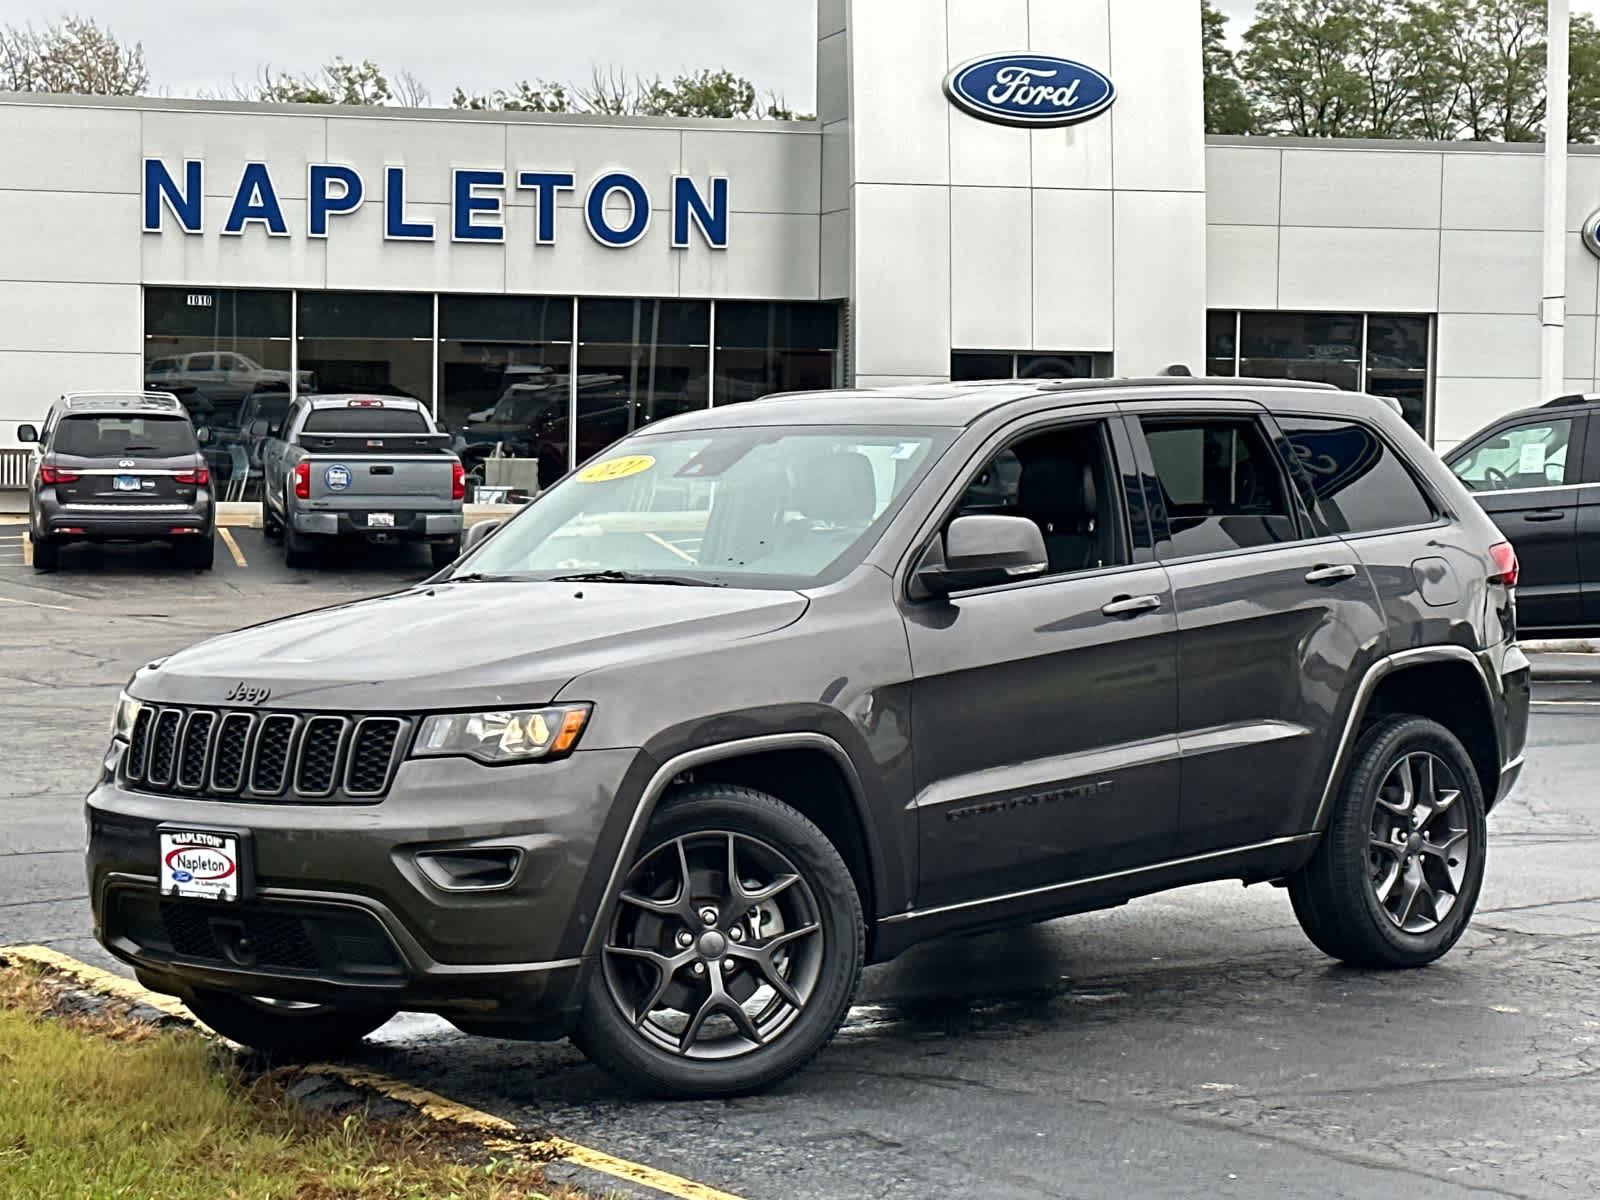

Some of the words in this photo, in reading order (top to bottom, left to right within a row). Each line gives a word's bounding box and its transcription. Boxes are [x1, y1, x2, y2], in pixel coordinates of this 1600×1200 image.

[987, 66, 1081, 107] Ford
[142, 157, 730, 250] NAPLETON
[187, 294, 212, 306] 1010
[225, 680, 272, 706] Jeep
[177, 854, 225, 873] Napleton
